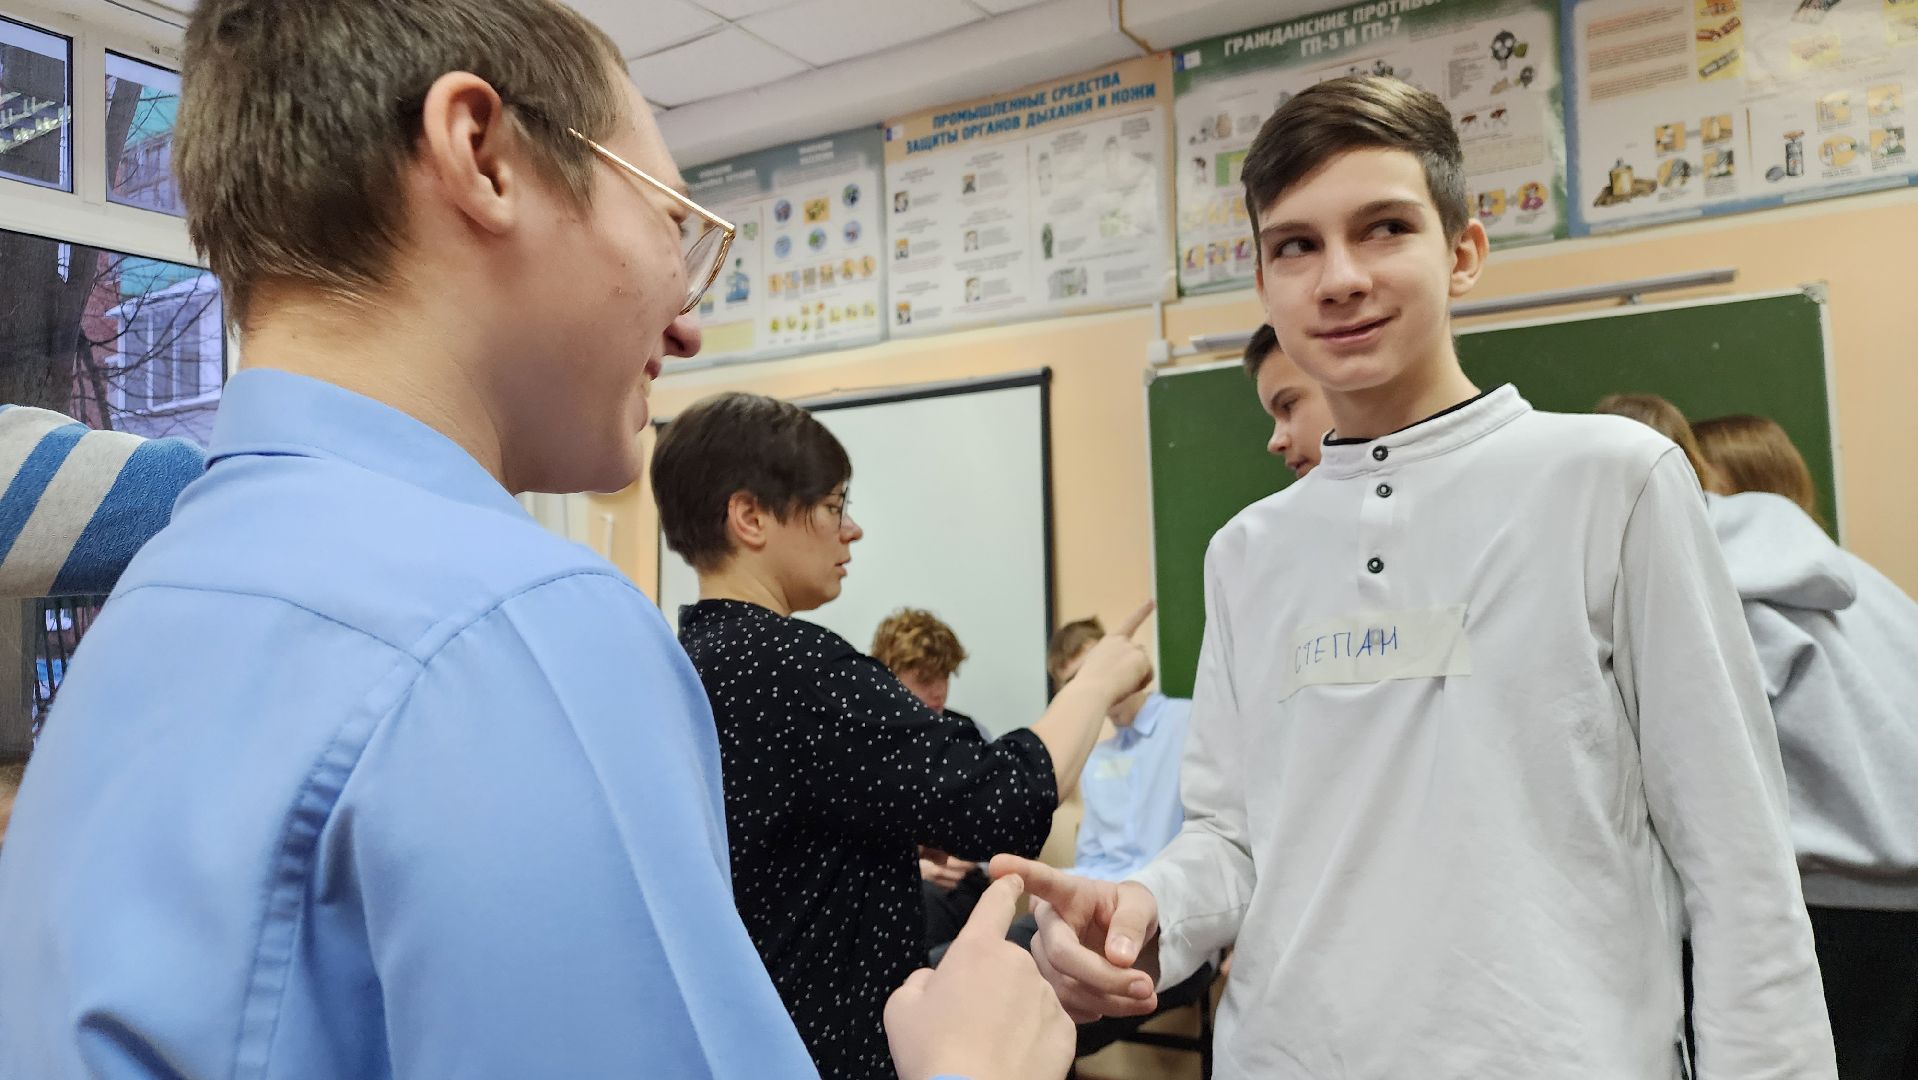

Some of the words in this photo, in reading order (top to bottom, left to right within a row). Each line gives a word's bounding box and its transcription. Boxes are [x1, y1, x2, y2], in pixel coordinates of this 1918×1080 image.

[1224, 10, 1347, 57] ГРАЖДАНСКИЕ
[1301, 31, 1339, 57] ГП-5
[1344, 27, 1356, 47] И
[1361, 15, 1400, 42] ГП-7
[906, 129, 959, 154] ЗАЩИТЫ
[962, 116, 1020, 140] ОРГАНОВ
[1026, 97, 1092, 129] ДЫХАНИЯ
[1098, 94, 1106, 107] И
[1111, 82, 1156, 105] КОЖИ
[932, 91, 1046, 129] ПРОМЫШЛЕННЫЕ
[1051, 71, 1120, 102] СРЕДСТВА
[1295, 626, 1398, 674] СТЕПАН
